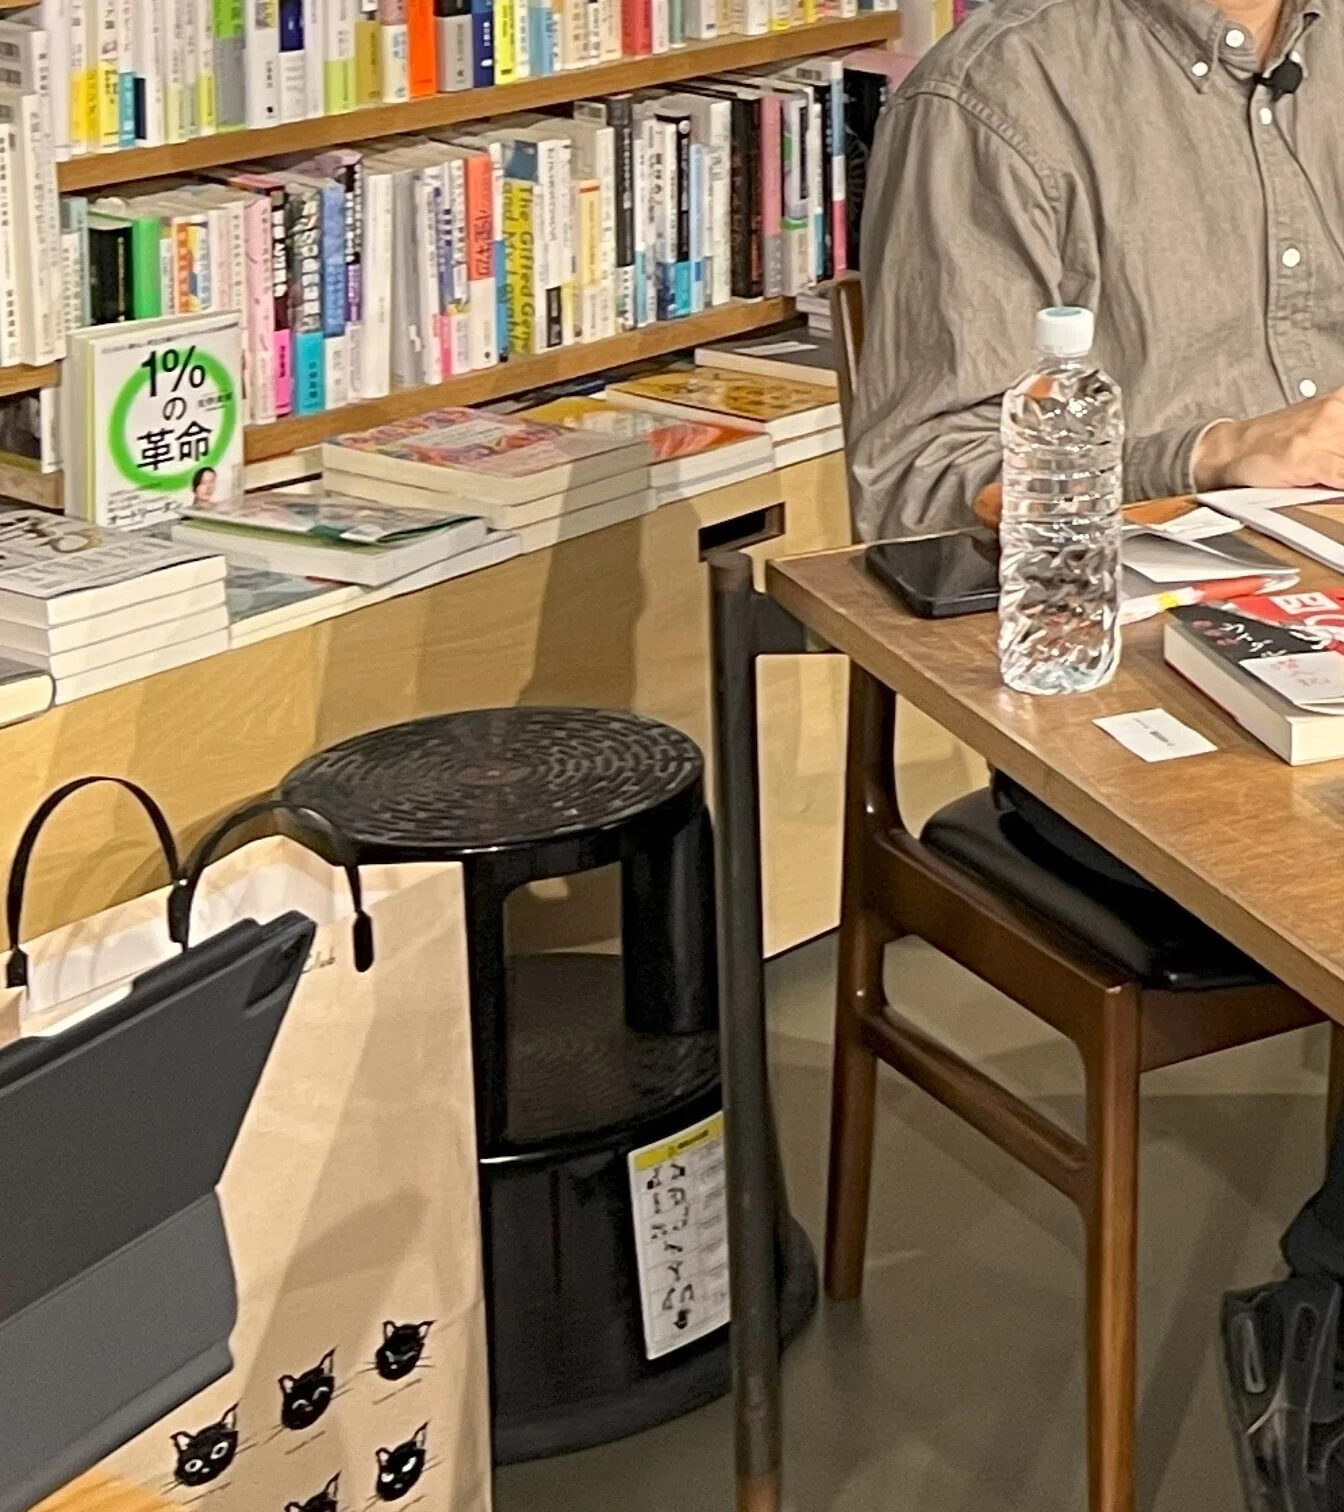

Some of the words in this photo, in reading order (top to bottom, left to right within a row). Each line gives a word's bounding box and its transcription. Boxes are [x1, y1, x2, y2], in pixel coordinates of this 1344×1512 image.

[141, 344, 207, 398] 1%
[162, 395, 188, 422] の
[136, 420, 213, 472] 革命
